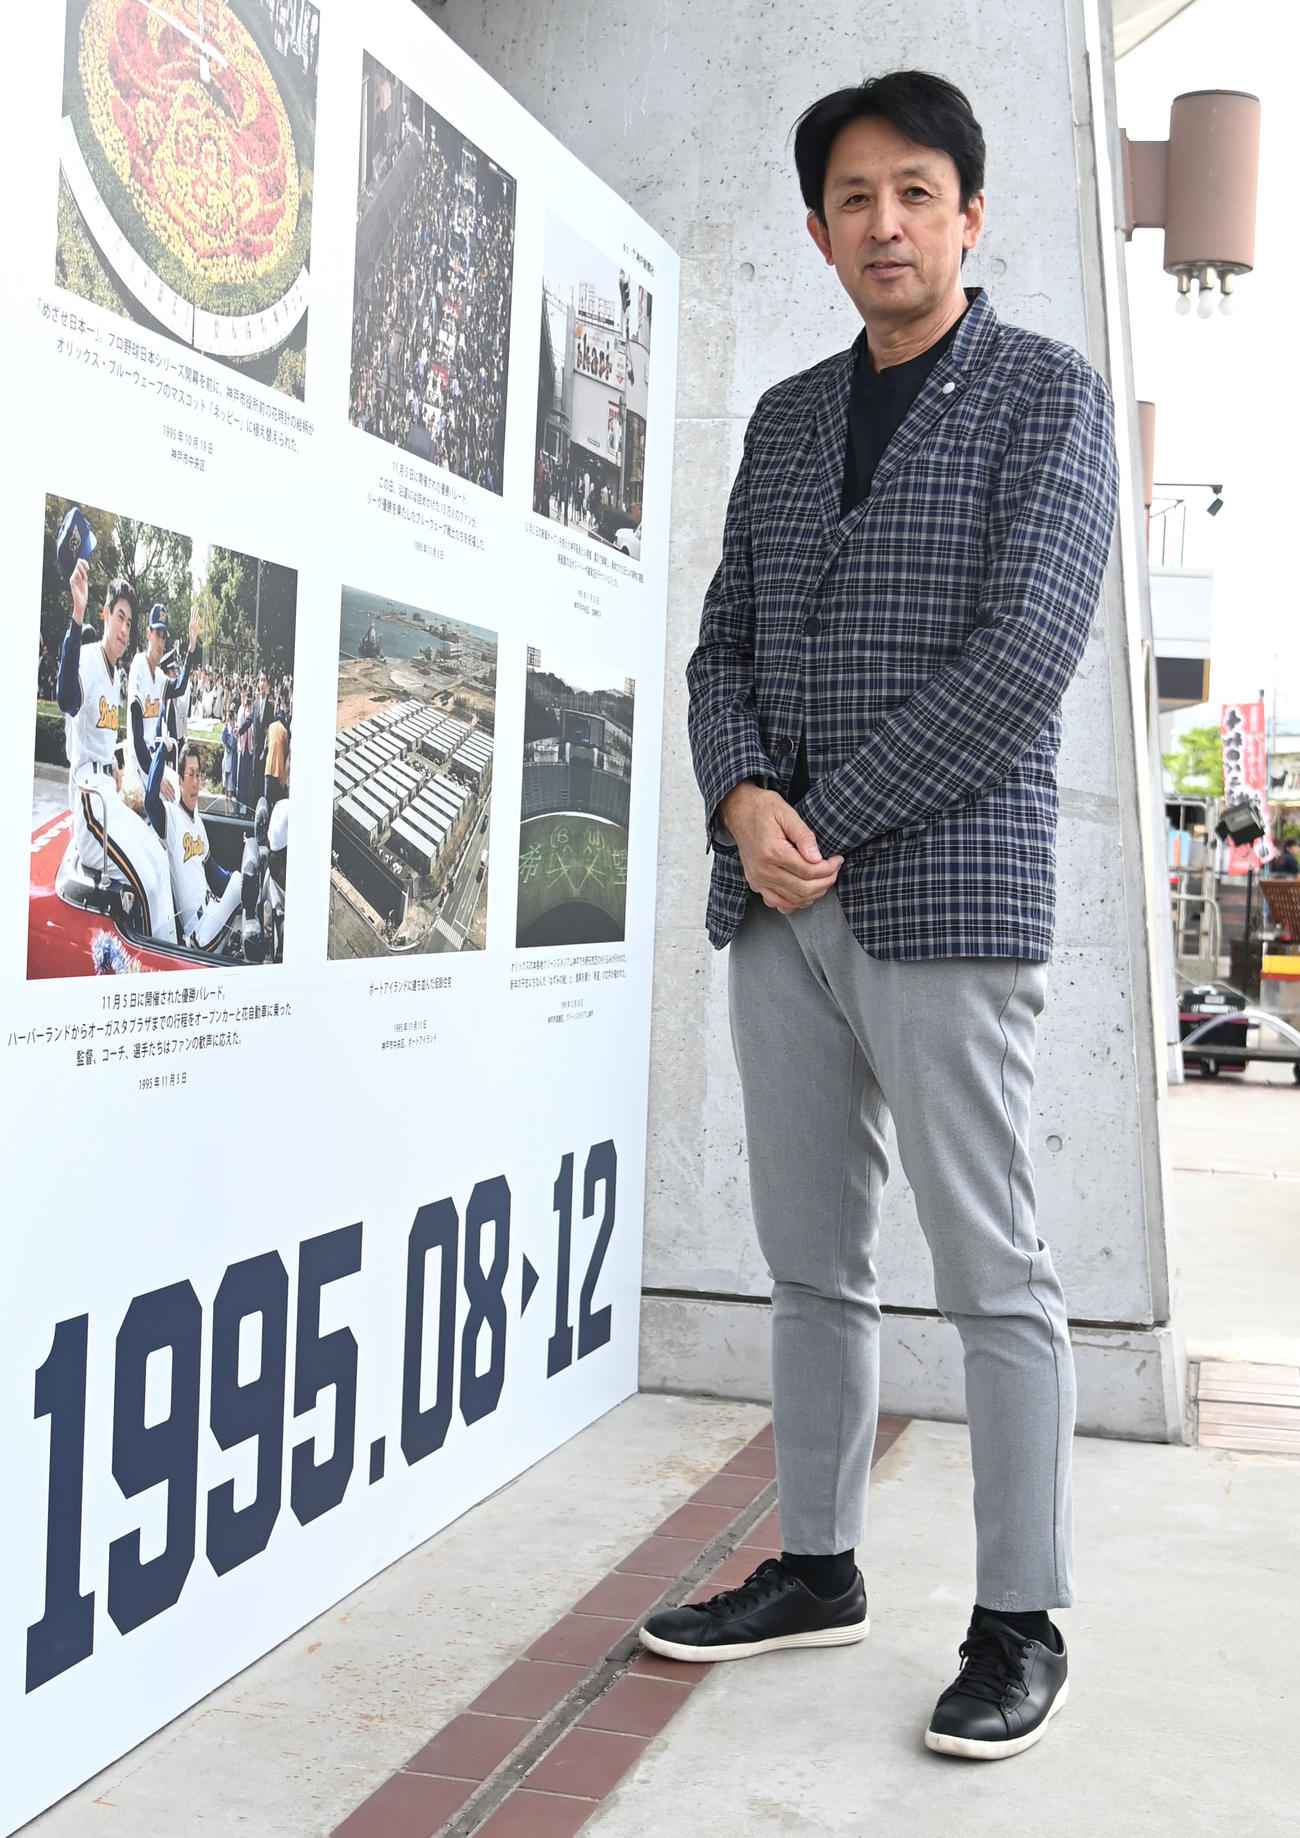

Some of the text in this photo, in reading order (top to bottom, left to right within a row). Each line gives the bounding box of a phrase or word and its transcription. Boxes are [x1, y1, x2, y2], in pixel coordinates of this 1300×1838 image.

[170, 448, 206, 472] 神戸市中央区
